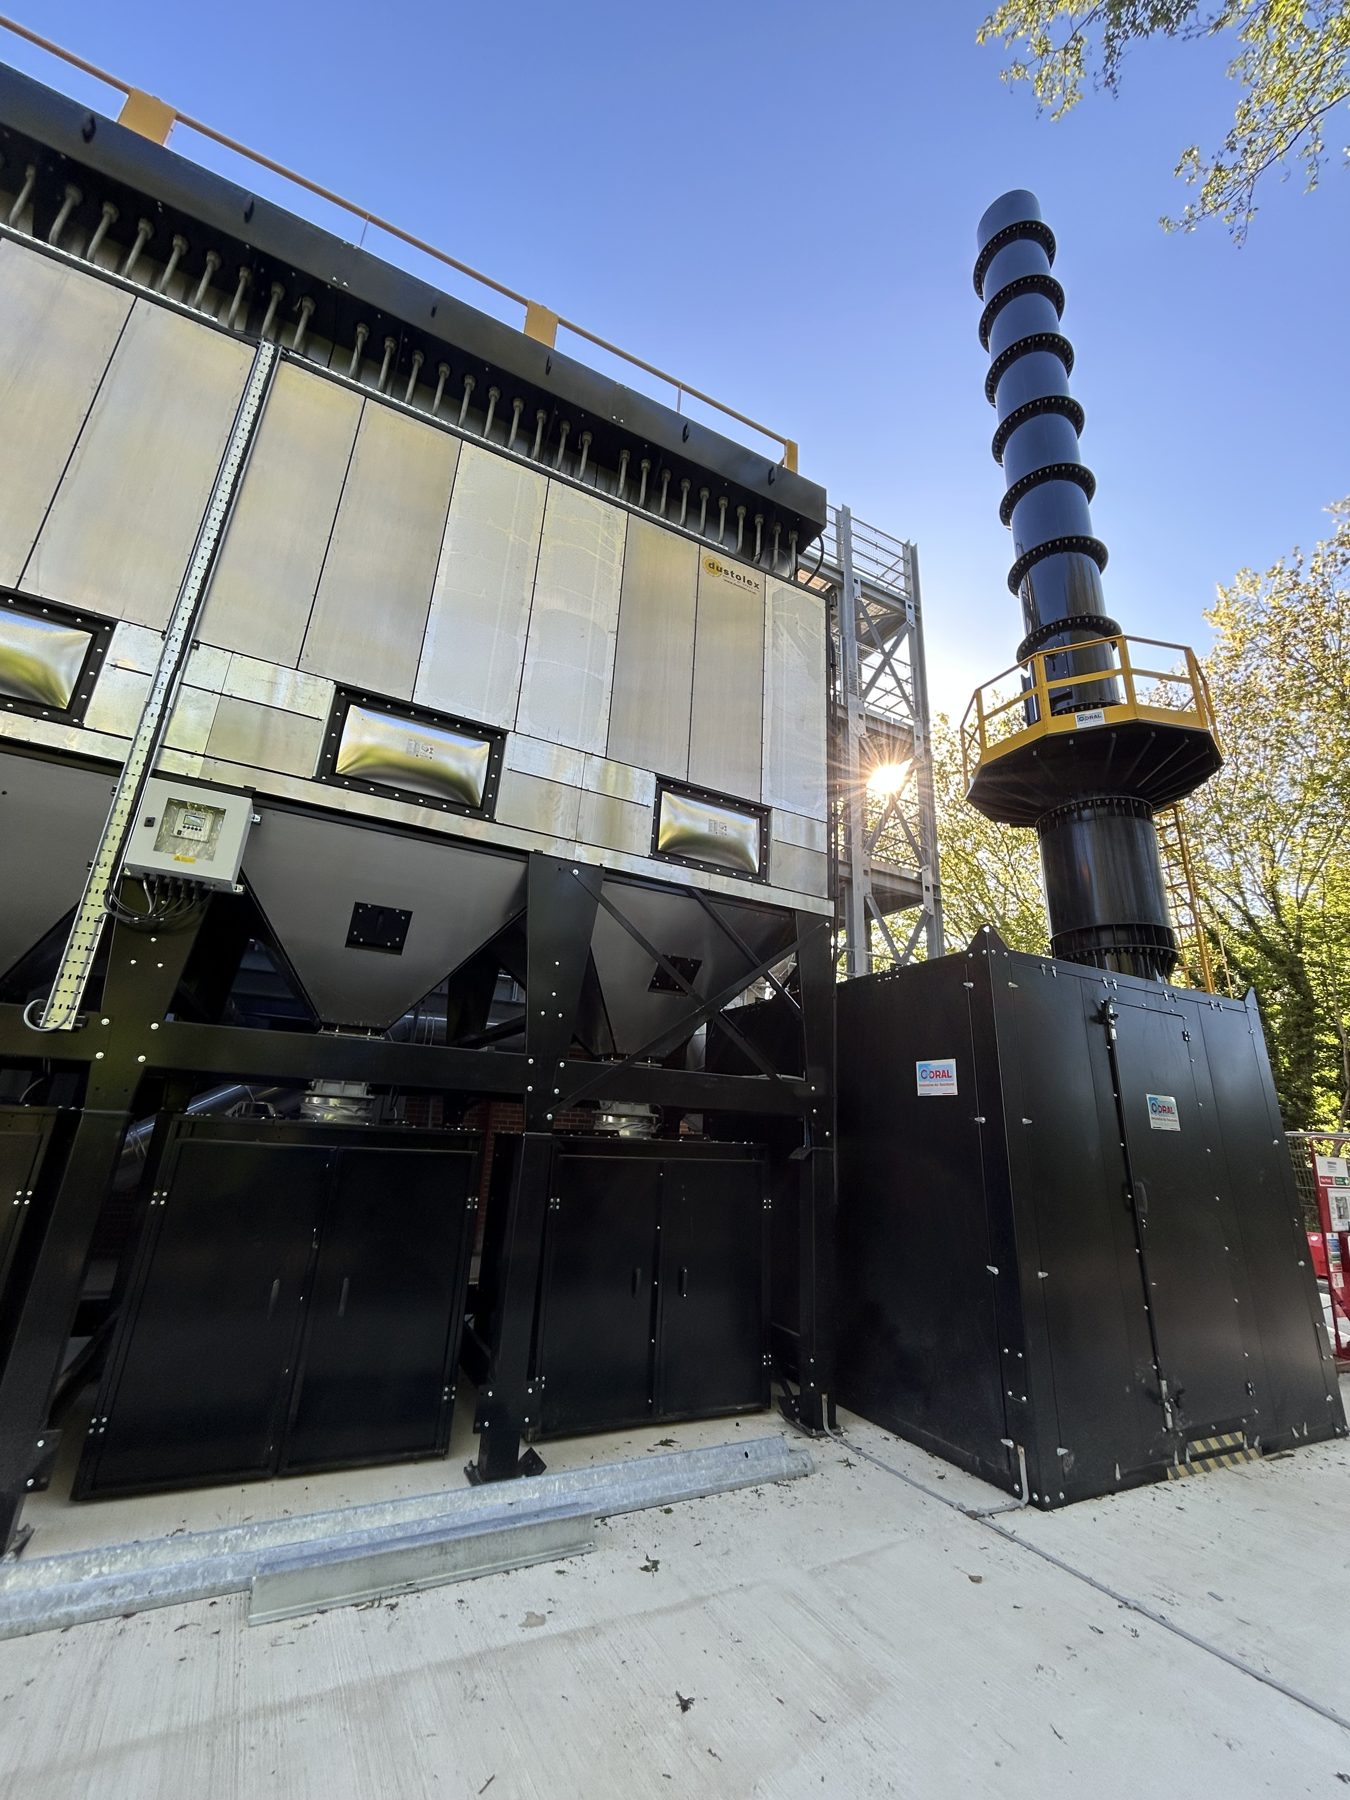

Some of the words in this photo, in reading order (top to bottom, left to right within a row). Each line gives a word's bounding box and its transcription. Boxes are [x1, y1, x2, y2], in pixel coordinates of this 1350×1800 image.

[708, 561, 760, 590] dustolex
[920, 1069, 952, 1080] CORAL
[1151, 1102, 1175, 1114] CORAL
